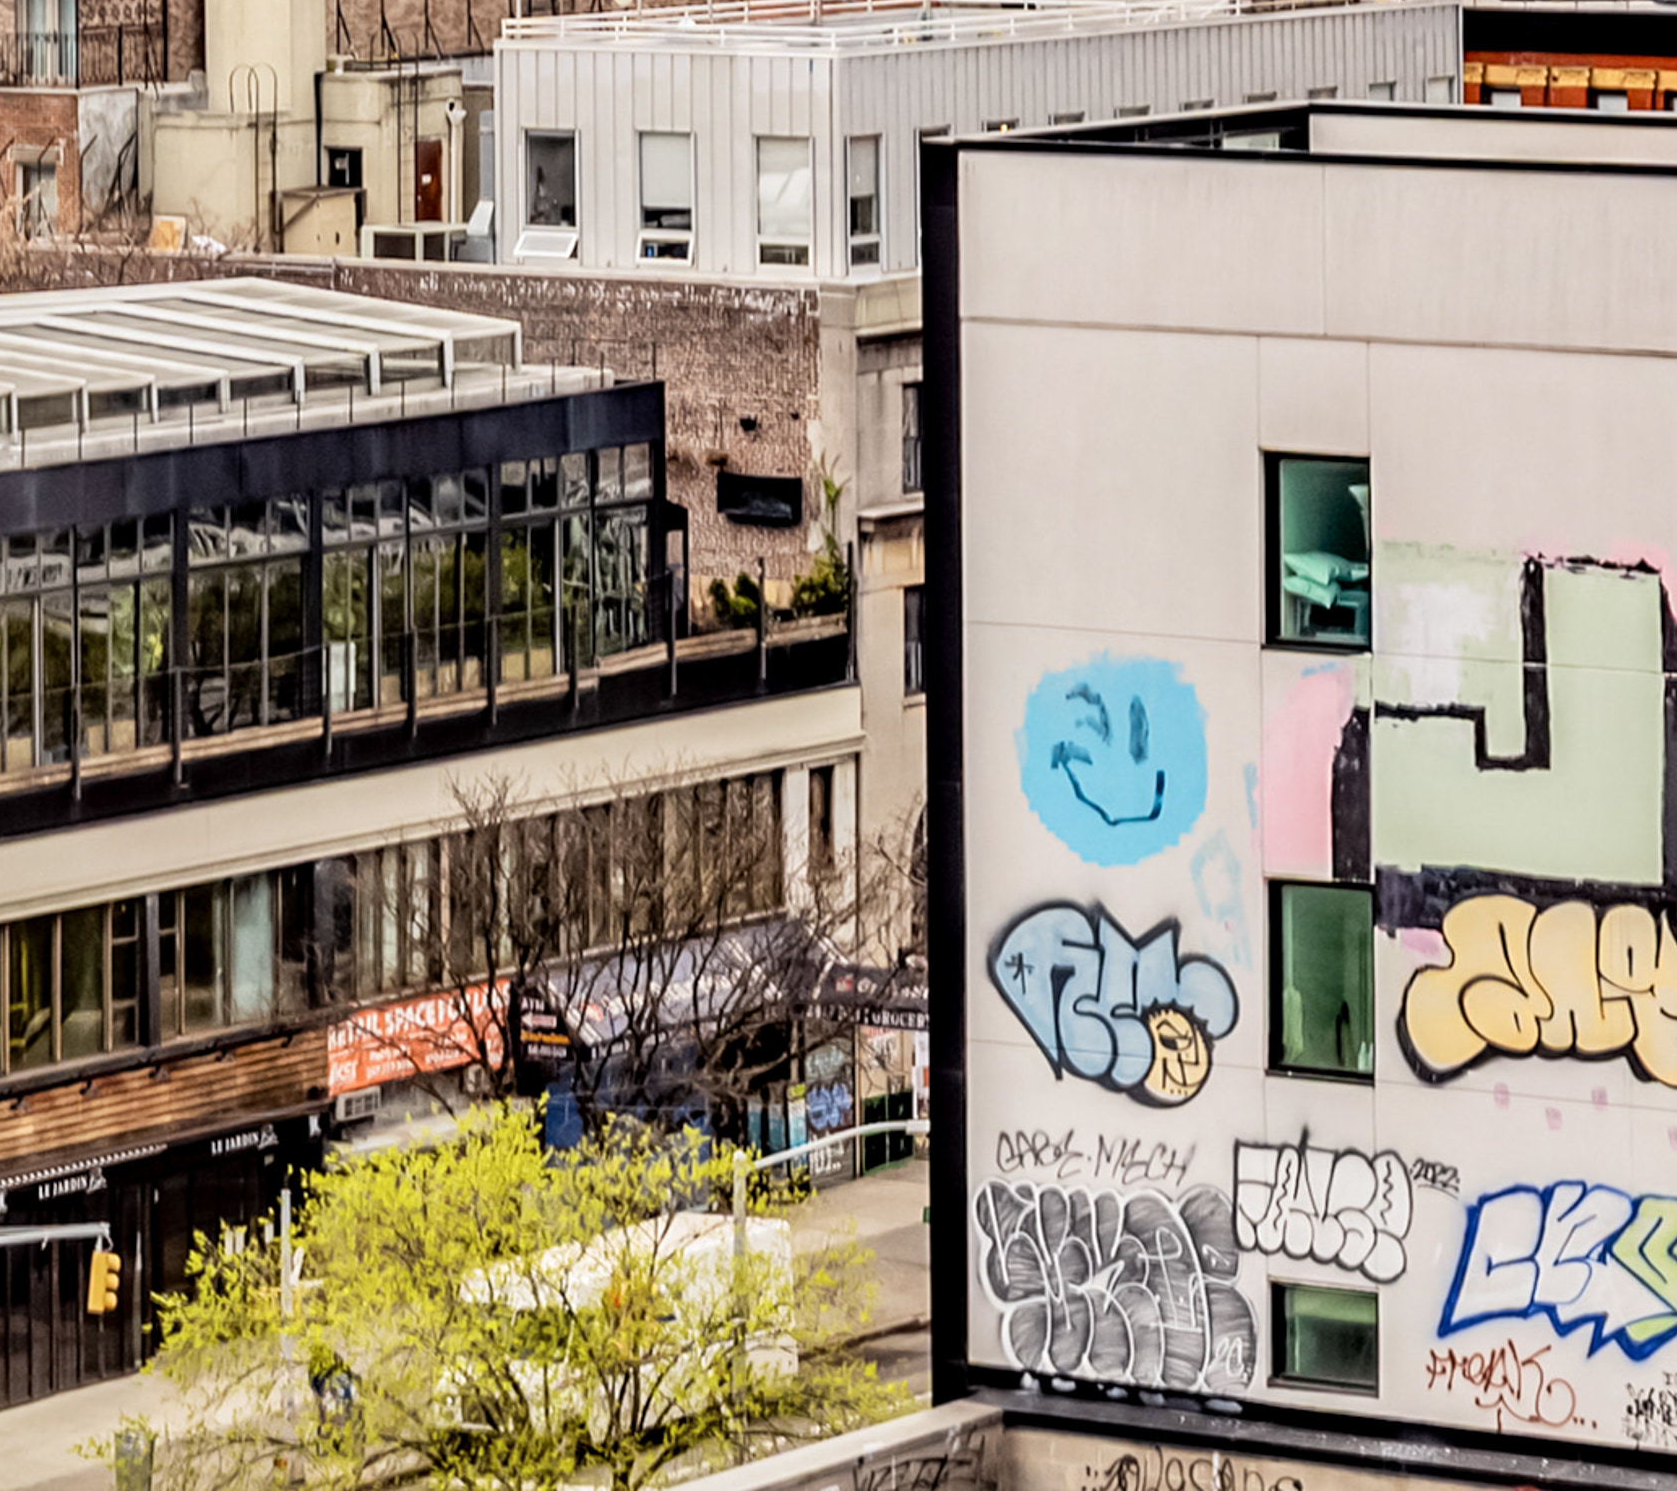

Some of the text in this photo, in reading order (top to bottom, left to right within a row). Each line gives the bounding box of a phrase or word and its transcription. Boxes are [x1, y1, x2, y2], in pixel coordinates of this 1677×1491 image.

[384, 999, 436, 1035] SPACE
[225, 1132, 260, 1154] JARDIN
[52, 1176, 89, 1197] JARDIN
